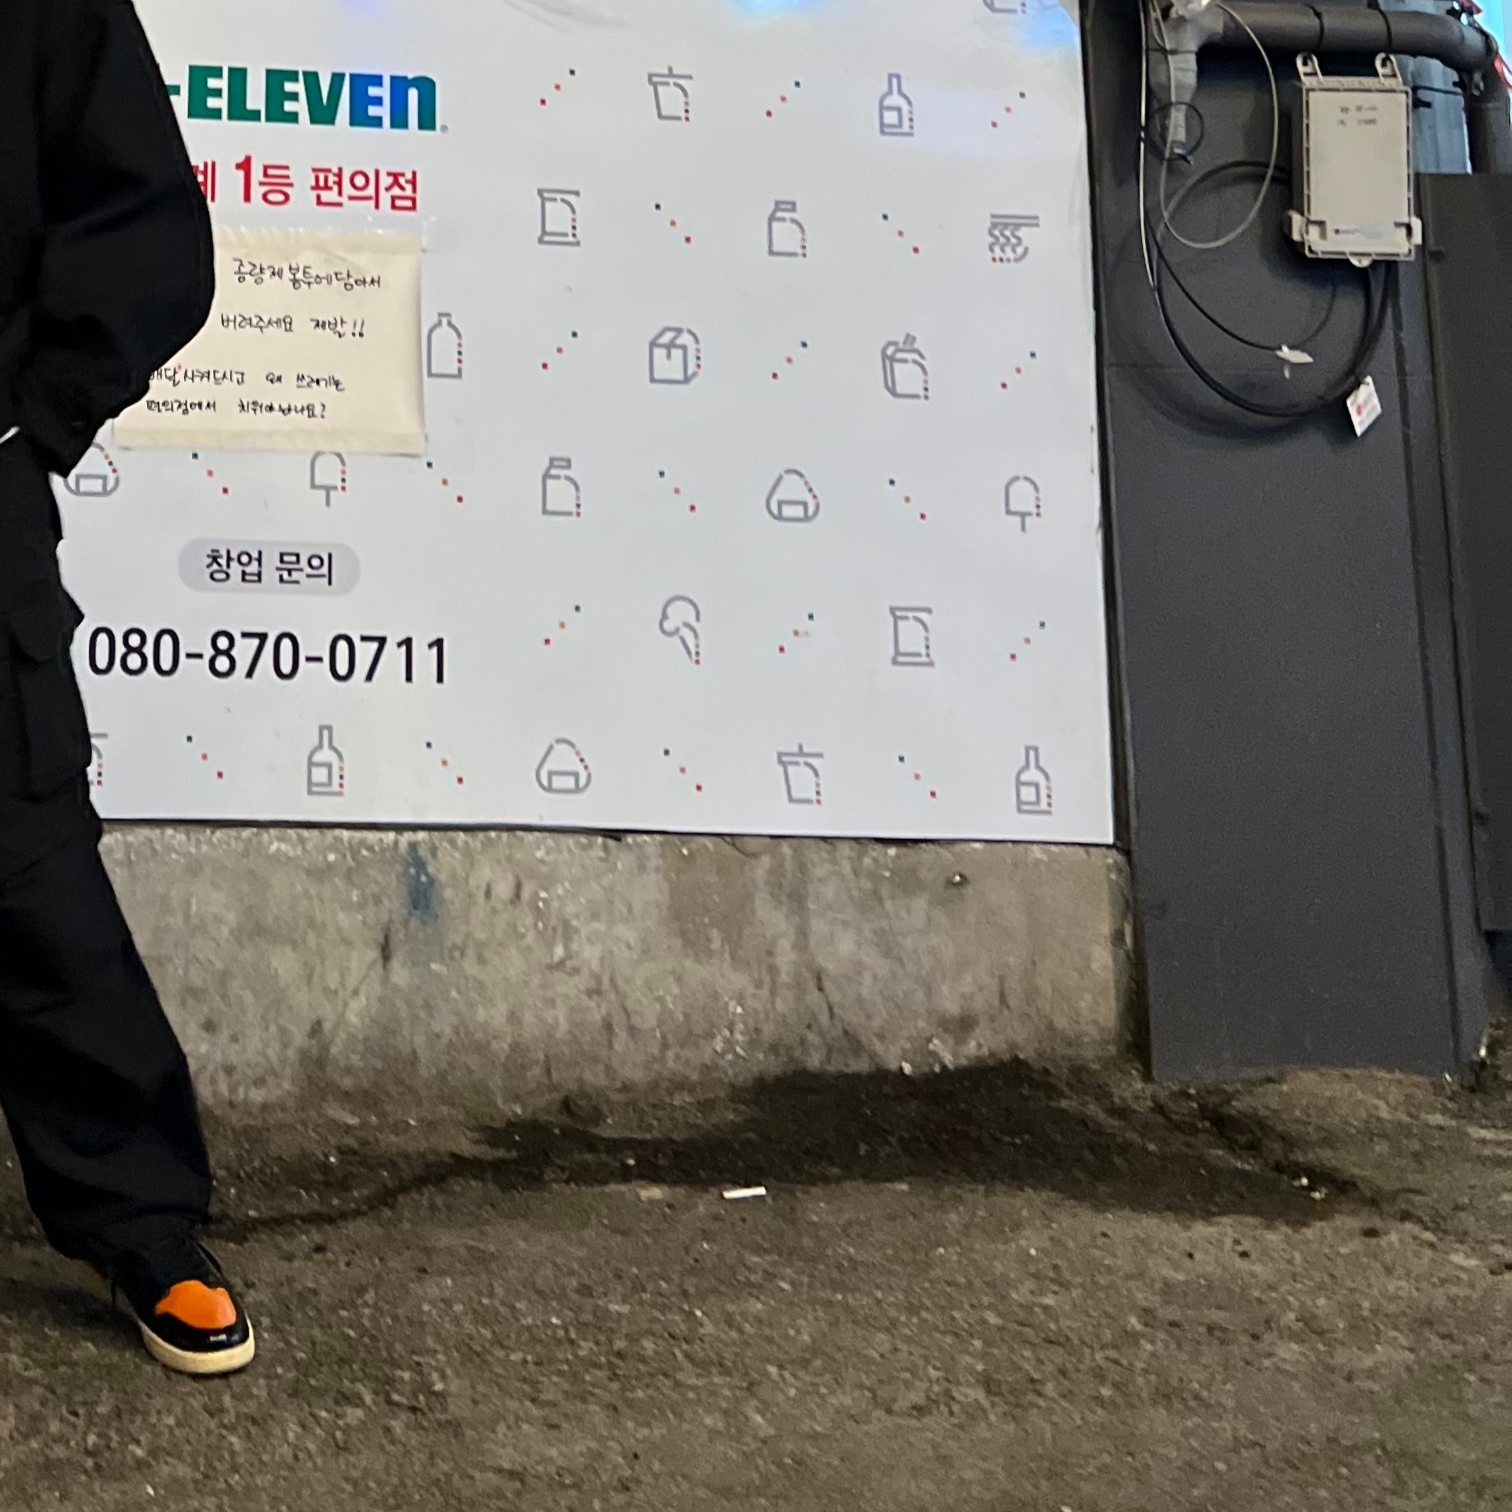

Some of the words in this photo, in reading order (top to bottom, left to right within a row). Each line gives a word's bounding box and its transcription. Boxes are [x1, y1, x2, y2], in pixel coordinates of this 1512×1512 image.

[234, 154, 295, 207] 1등
[310, 166, 419, 212] 편의점
[232, 257, 284, 285] 종량제
[220, 313, 294, 334] 버려주세요
[309, 316, 365, 339] 제발!!
[146, 399, 217, 416] 편의점에서
[204, 547, 264, 584] 창업
[275, 551, 335, 587] 문의
[87, 626, 446, 686] 080-870-0711
